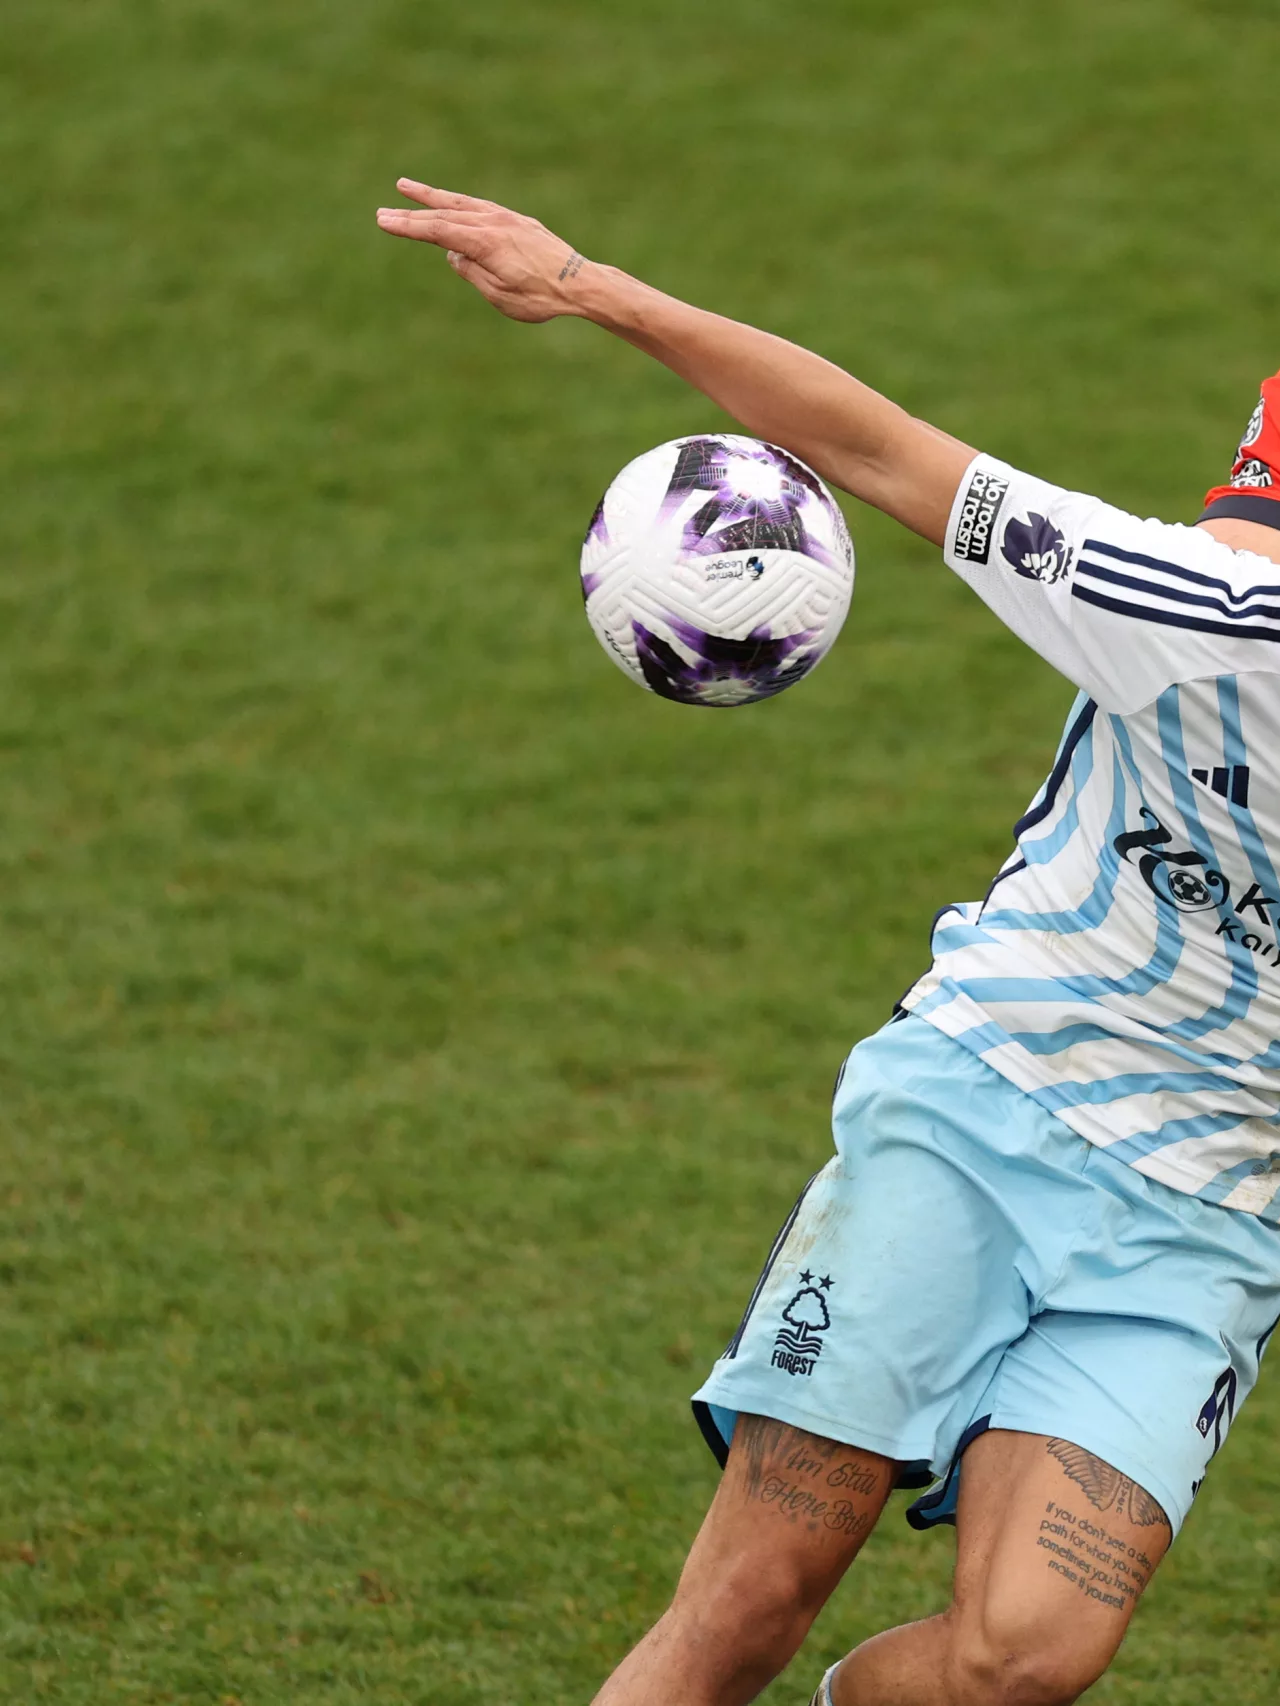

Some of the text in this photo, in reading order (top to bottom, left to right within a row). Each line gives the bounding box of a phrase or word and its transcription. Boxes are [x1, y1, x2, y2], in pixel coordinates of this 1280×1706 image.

[954, 496, 981, 559] racism
[971, 476, 1009, 554] No room
[704, 559, 744, 571] League
[705, 570, 744, 582] Premier
[761, 1476, 828, 1517] Here
[1040, 1520, 1067, 1538] path
[1069, 1531, 1086, 1548] for
[1086, 1544, 1111, 1563] what
[1112, 1558, 1130, 1574] you
[1055, 1507, 1076, 1524] you
[1078, 1519, 1106, 1541] don't
[1106, 1536, 1126, 1551] see
[1128, 1548, 1136, 1558] a
[1036, 1536, 1091, 1573] sometimes
[1090, 1567, 1112, 1584] you
[1048, 1560, 1077, 1582] make
[1078, 1577, 1086, 1589] it
